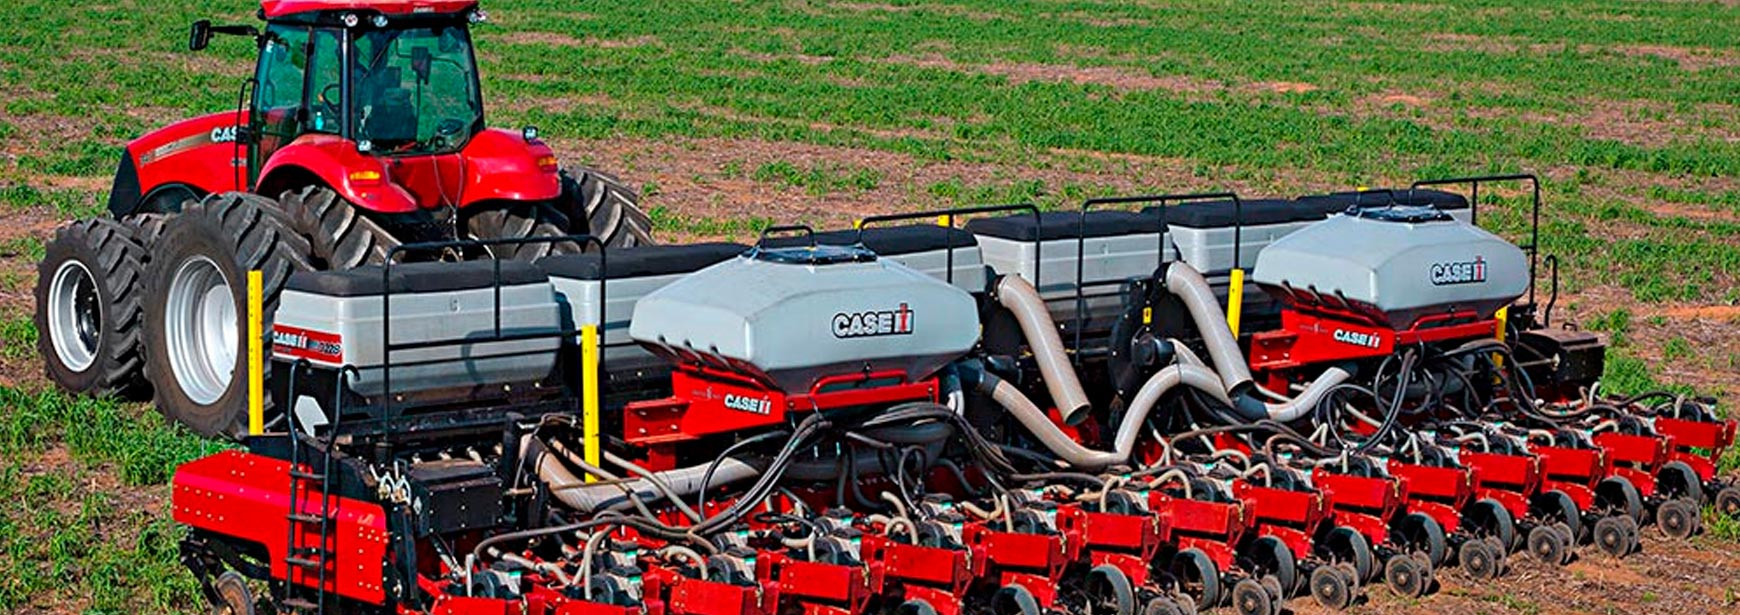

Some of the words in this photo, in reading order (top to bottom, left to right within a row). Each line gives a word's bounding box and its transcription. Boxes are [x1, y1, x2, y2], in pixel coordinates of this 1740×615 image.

[1430, 261, 1471, 285] CASE
[832, 311, 893, 338] CASE
[1335, 328, 1367, 345] CASE
[725, 393, 758, 413] CASE
